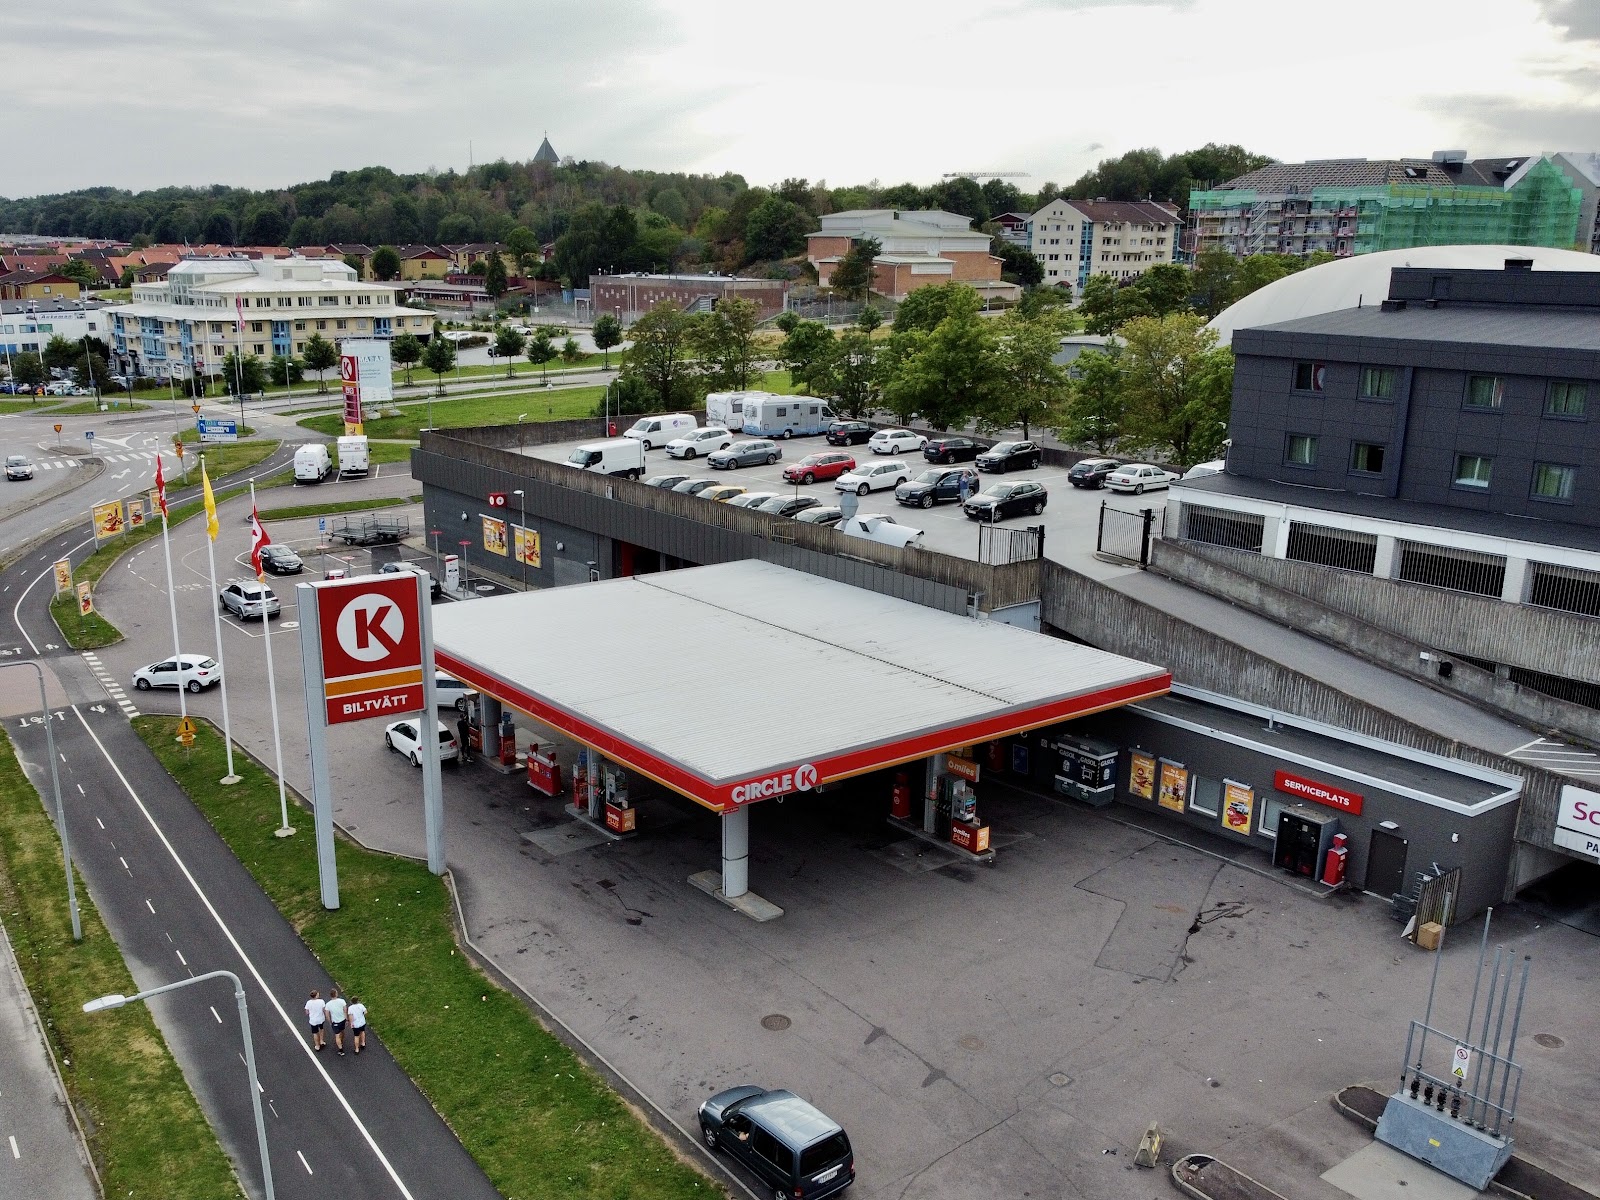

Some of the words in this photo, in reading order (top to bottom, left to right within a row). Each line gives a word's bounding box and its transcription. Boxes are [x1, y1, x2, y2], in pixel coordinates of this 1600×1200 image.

[354, 604, 400, 655] K
[343, 694, 408, 715] BILTVÄTT
[731, 774, 792, 803] CIRCLE
[800, 767, 817, 788] K
[1284, 779, 1350, 806] SERVICEPLATS
[1586, 841, 1600, 854] PA
